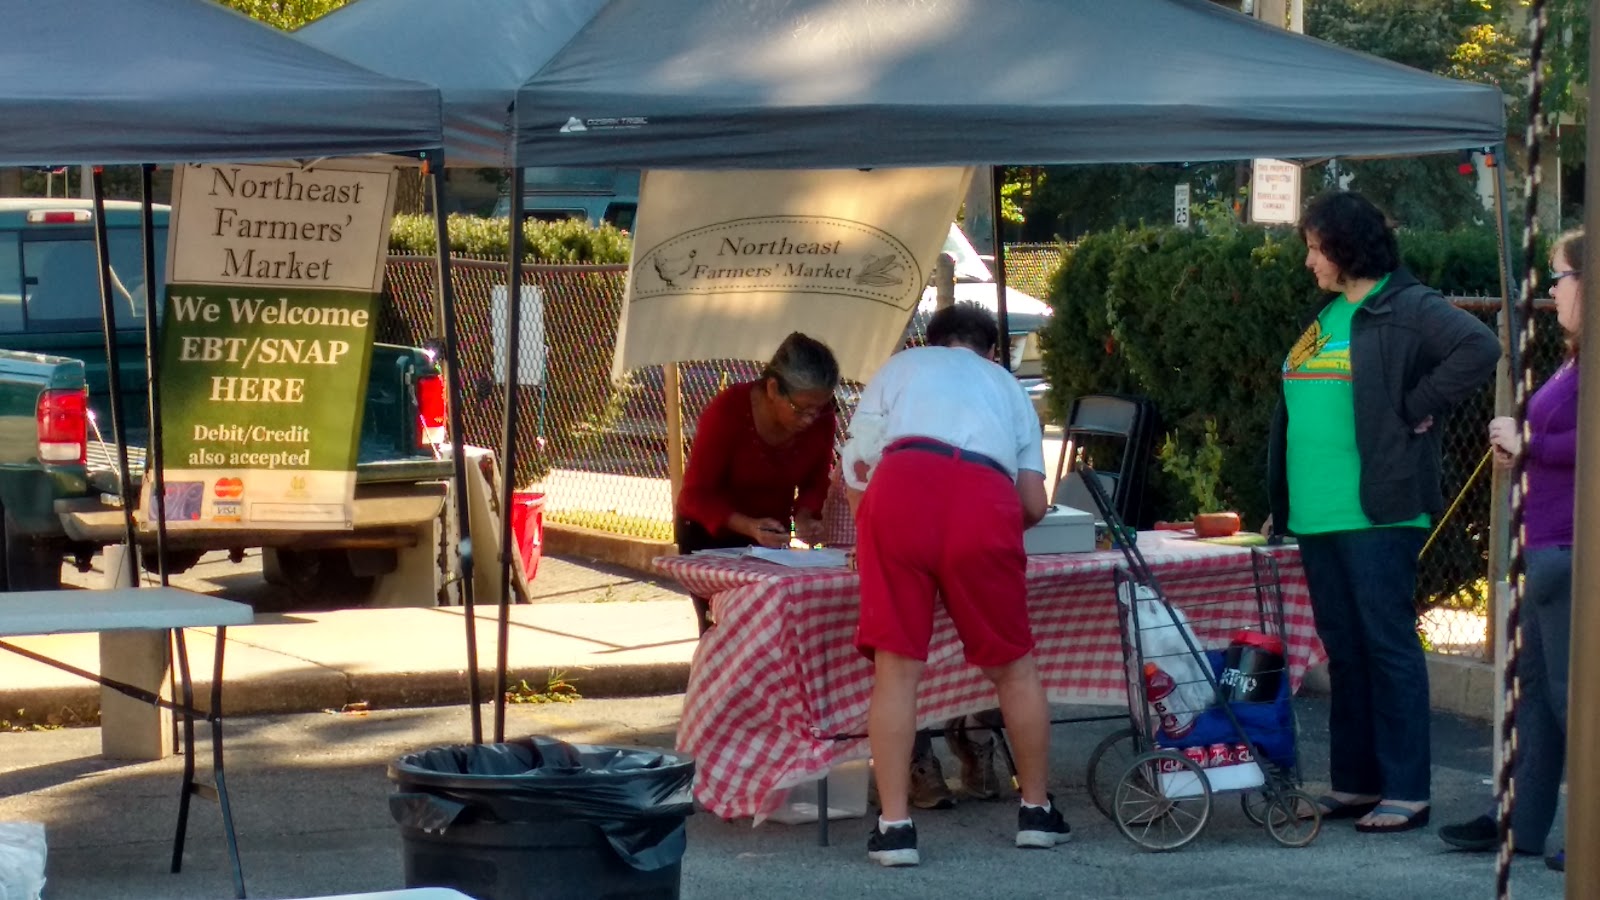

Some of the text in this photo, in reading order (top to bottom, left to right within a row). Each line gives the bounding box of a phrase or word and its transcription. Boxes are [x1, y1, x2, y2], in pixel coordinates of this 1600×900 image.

[208, 167, 364, 204] Northeast
[212, 207, 353, 242] Farmers'
[1176, 207, 1188, 223] 25
[717, 236, 842, 258] Northeast
[221, 248, 333, 281] Market
[692, 262, 851, 281] Farmers' Market
[171, 296, 369, 328] We Welcome
[178, 336, 350, 369] EBT/SNAP
[209, 376, 305, 403] HERE
[193, 424, 310, 445] Debit/Credit
[188, 448, 310, 469] also accepted
[217, 506, 236, 514] VISA
